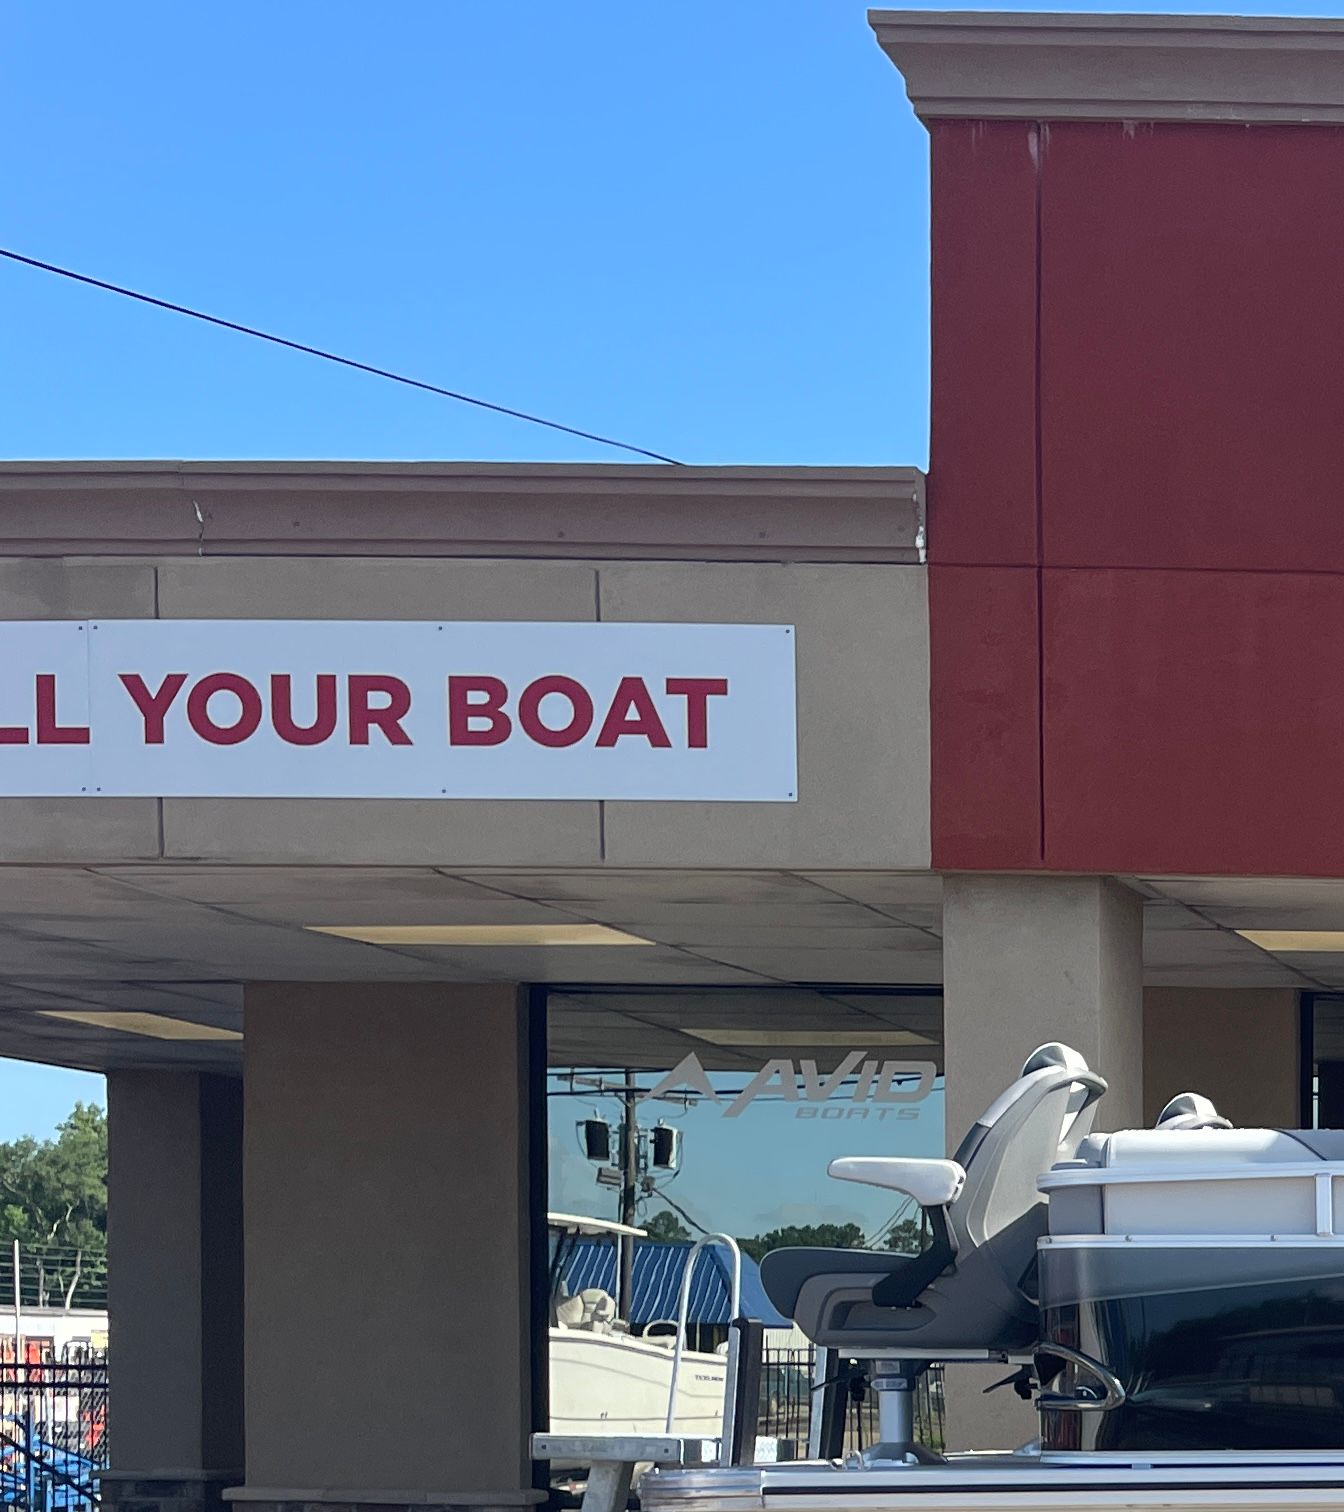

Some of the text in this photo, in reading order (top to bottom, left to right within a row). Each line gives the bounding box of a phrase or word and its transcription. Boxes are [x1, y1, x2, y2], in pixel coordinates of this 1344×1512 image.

[116, 671, 415, 747] YOUR
[447, 675, 730, 750] BOAT
[721, 1050, 938, 1119] AVID
[794, 1106, 921, 1121] BOATS
